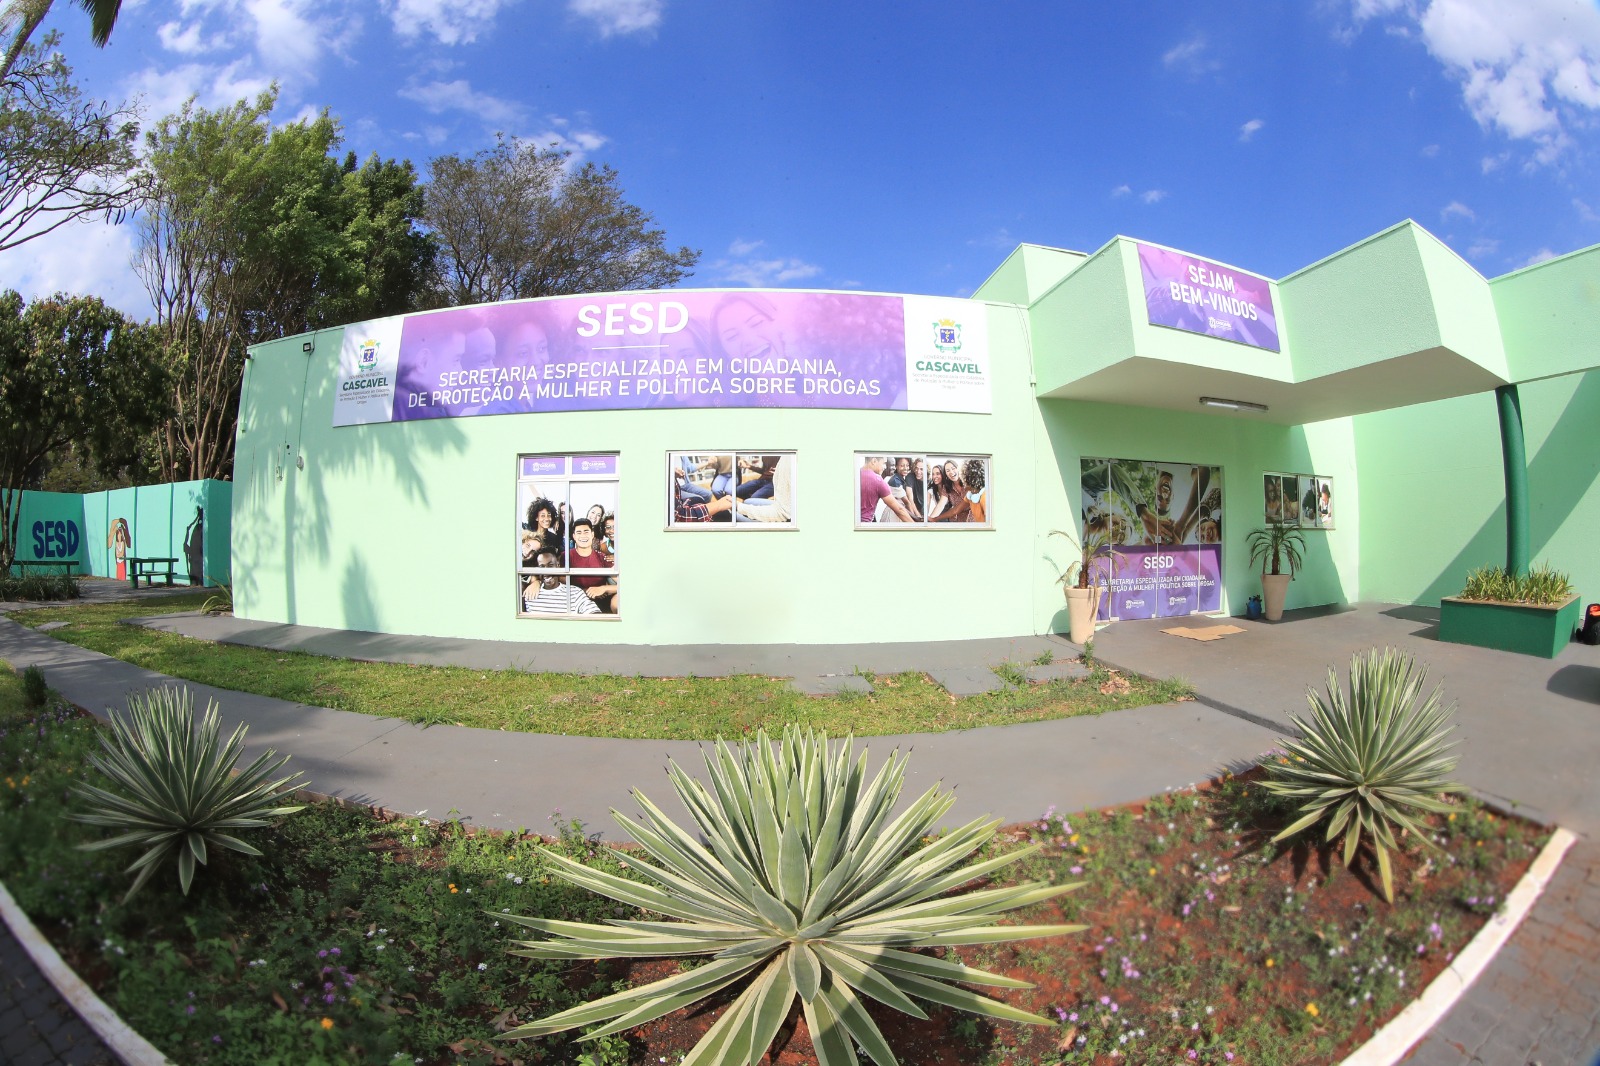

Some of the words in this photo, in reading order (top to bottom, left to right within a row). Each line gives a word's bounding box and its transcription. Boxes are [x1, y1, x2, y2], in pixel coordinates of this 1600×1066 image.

[1188, 264, 1236, 294] SEJAM
[1170, 281, 1258, 321] BEM-VINDOS
[576, 301, 689, 338] SESD
[438, 365, 538, 388] SECRETARIA
[543, 358, 689, 380] ESPECIALIZADA
[695, 358, 723, 375] EM
[730, 358, 842, 378] CIDADANIA,
[915, 361, 982, 374] CASCAVEL
[342, 377, 389, 391] CASCAVEL
[408, 392, 427, 408] DE
[431, 382, 514, 406] PROTEÇÃO
[518, 381, 531, 400] À
[536, 380, 612, 399] MULHER
[618, 379, 630, 395] E
[636, 374, 724, 396] POLÍTICA
[730, 377, 796, 394] SOBRE
[803, 379, 881, 396] DROGAS
[32, 519, 80, 559] SESD
[1144, 556, 1174, 569] SESD
